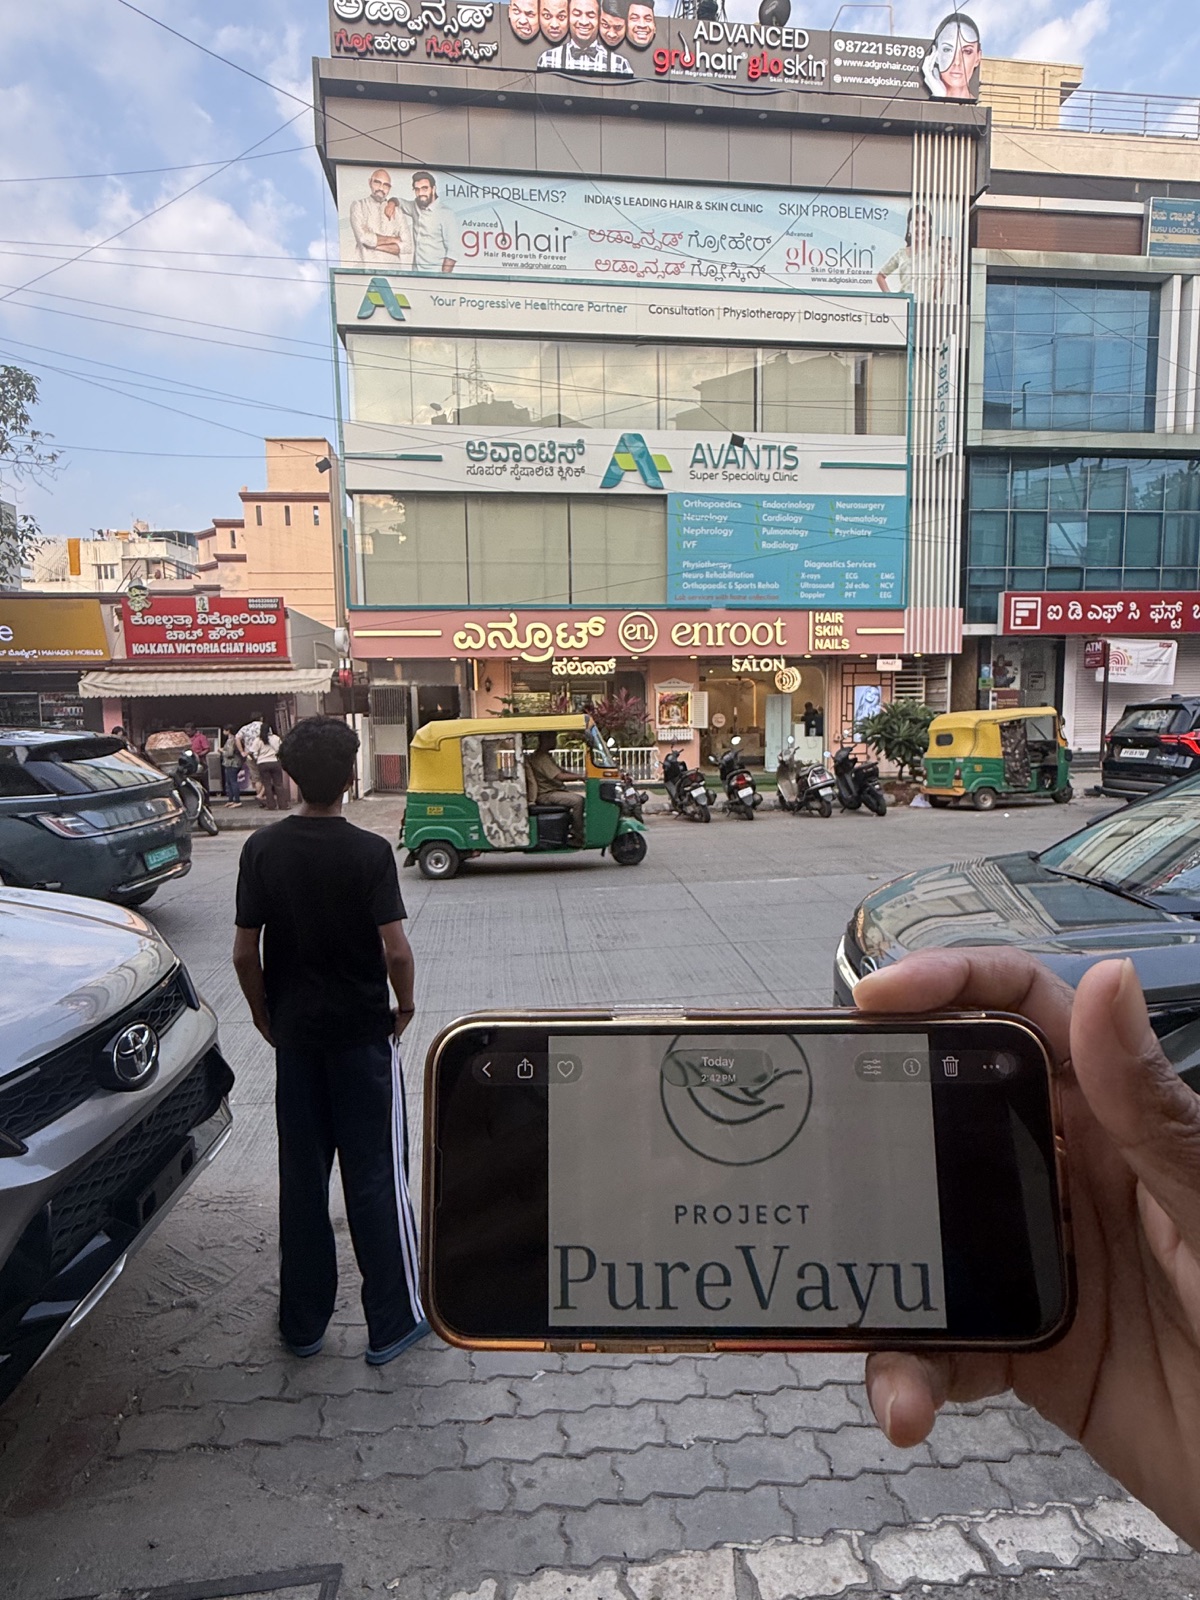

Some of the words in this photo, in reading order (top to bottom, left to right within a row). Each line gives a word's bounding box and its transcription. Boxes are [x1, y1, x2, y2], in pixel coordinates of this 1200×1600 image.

[693, 21, 809, 49] ADVANCED
[846, 40, 882, 54] 87221
[885, 43, 924, 59] 56789
[842, 75, 919, 88] www.adgloskin.com
[445, 184, 479, 199] HAIR
[482, 186, 567, 203] PROBLEMS?
[584, 194, 622, 206] INDIA'S
[623, 196, 667, 208] LEADING
[670, 200, 694, 210] HAIR
[696, 201, 702, 210] &
[704, 201, 728, 212] SKIN
[730, 202, 764, 213] CLINIC
[778, 203, 809, 217] SKIN
[812, 204, 889, 221] PROBLEMS?
[462, 220, 498, 228] Advanced
[502, 252, 537, 260] Regrowth
[538, 253, 567, 261] Forever
[502, 261, 567, 270] www.adgrohair.com
[811, 276, 873, 284] www.adgloskin.com
[430, 295, 457, 307] Your
[460, 296, 522, 311] Progressive
[524, 299, 584, 312] Healthcare
[587, 302, 628, 314] Partner
[648, 304, 715, 317] Consultation
[723, 307, 796, 322] Physiotherapy
[804, 310, 862, 324] Diagnostics
[870, 312, 890, 324] Lab
[690, 442, 799, 471] AVANTIS
[690, 470, 719, 482] Super
[722, 470, 770, 484] Speciality
[772, 470, 798, 482] Clinic
[683, 500, 742, 510] Orthopaedics
[762, 500, 816, 511] Endocrinology
[836, 501, 886, 511] Neurosurgery
[683, 513, 728, 523] Neurology
[762, 514, 803, 524] Cardiology
[835, 514, 888, 524] Rheumatology
[683, 527, 734, 536] Nephrology
[762, 528, 808, 537] Pulmonology
[834, 528, 872, 537] Psychiatry
[682, 540, 698, 548] IVF
[762, 541, 798, 551] Radiology
[682, 560, 732, 570] Physiotherapy
[804, 560, 846, 570] Diagnostics
[846, 560, 876, 568] Services
[705, 571, 754, 579] Rehabilitation
[682, 582, 727, 590] Orthopaedic
[734, 582, 756, 590] Sports
[1046, 604, 1063, 620] ಐ
[1068, 601, 1083, 620] ಡಿ
[1087, 601, 1124, 624] ಎಫ್
[1128, 603, 1140, 620] ಸಿ
[814, 612, 844, 624] HAIR
[670, 617, 788, 646] enroot
[814, 626, 844, 636] SKIN
[132, 643, 174, 654] KOLKATA
[175, 642, 220, 654] VICTORIA
[220, 642, 244, 654] CHAT
[245, 642, 277, 654] HOUSE
[814, 638, 850, 650] NAILS
[1086, 642, 1102, 652] ATM
[552, 657, 616, 676] ಸಲೂನ್
[732, 658, 786, 672] SALON
[702, 1056, 735, 1069] Today
[702, 1074, 722, 1082] 2:42
[722, 1074, 736, 1082] PM
[675, 1204, 810, 1225] PROJECT
[552, 1244, 938, 1328] PureVayu
